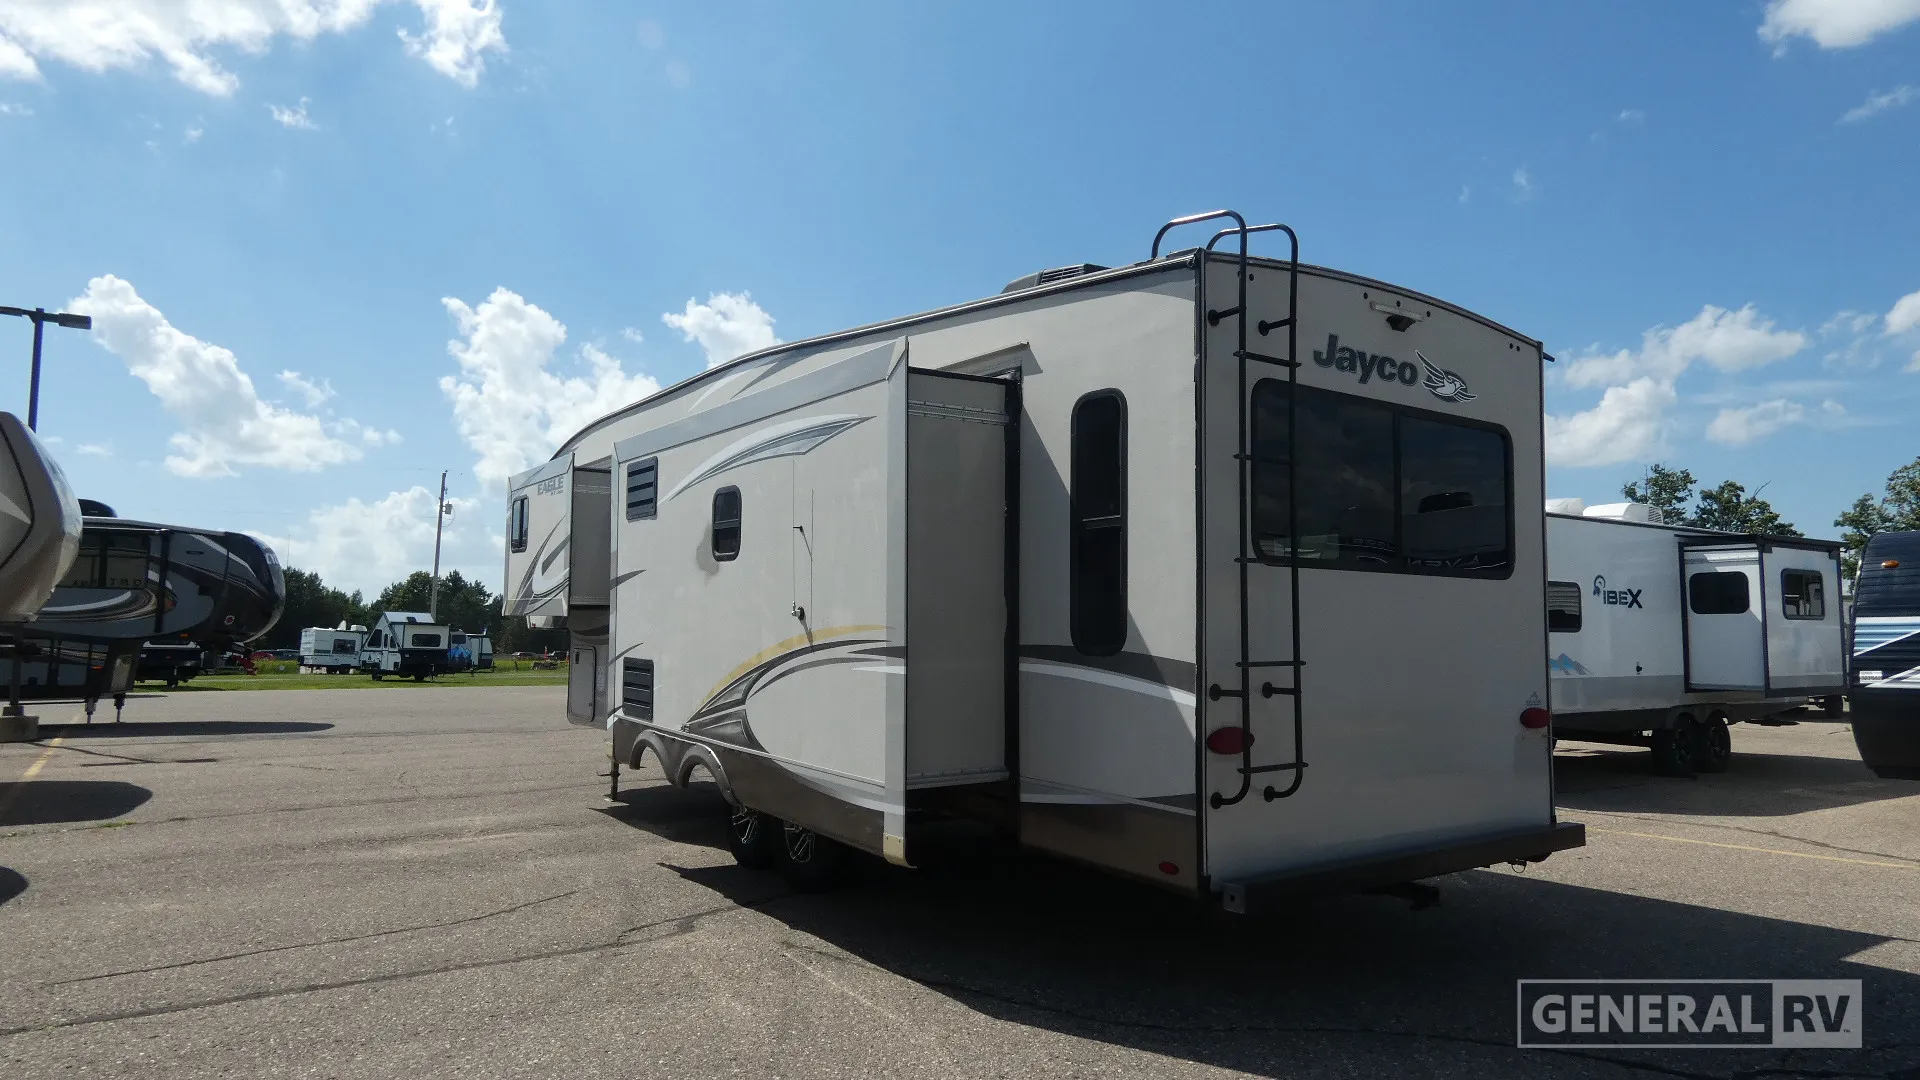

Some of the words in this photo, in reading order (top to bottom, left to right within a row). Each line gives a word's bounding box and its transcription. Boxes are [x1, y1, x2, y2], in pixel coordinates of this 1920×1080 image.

[1313, 333, 1418, 386] Jayco
[537, 476, 564, 496] EAGLE
[1603, 588, 1643, 608] IBEX
